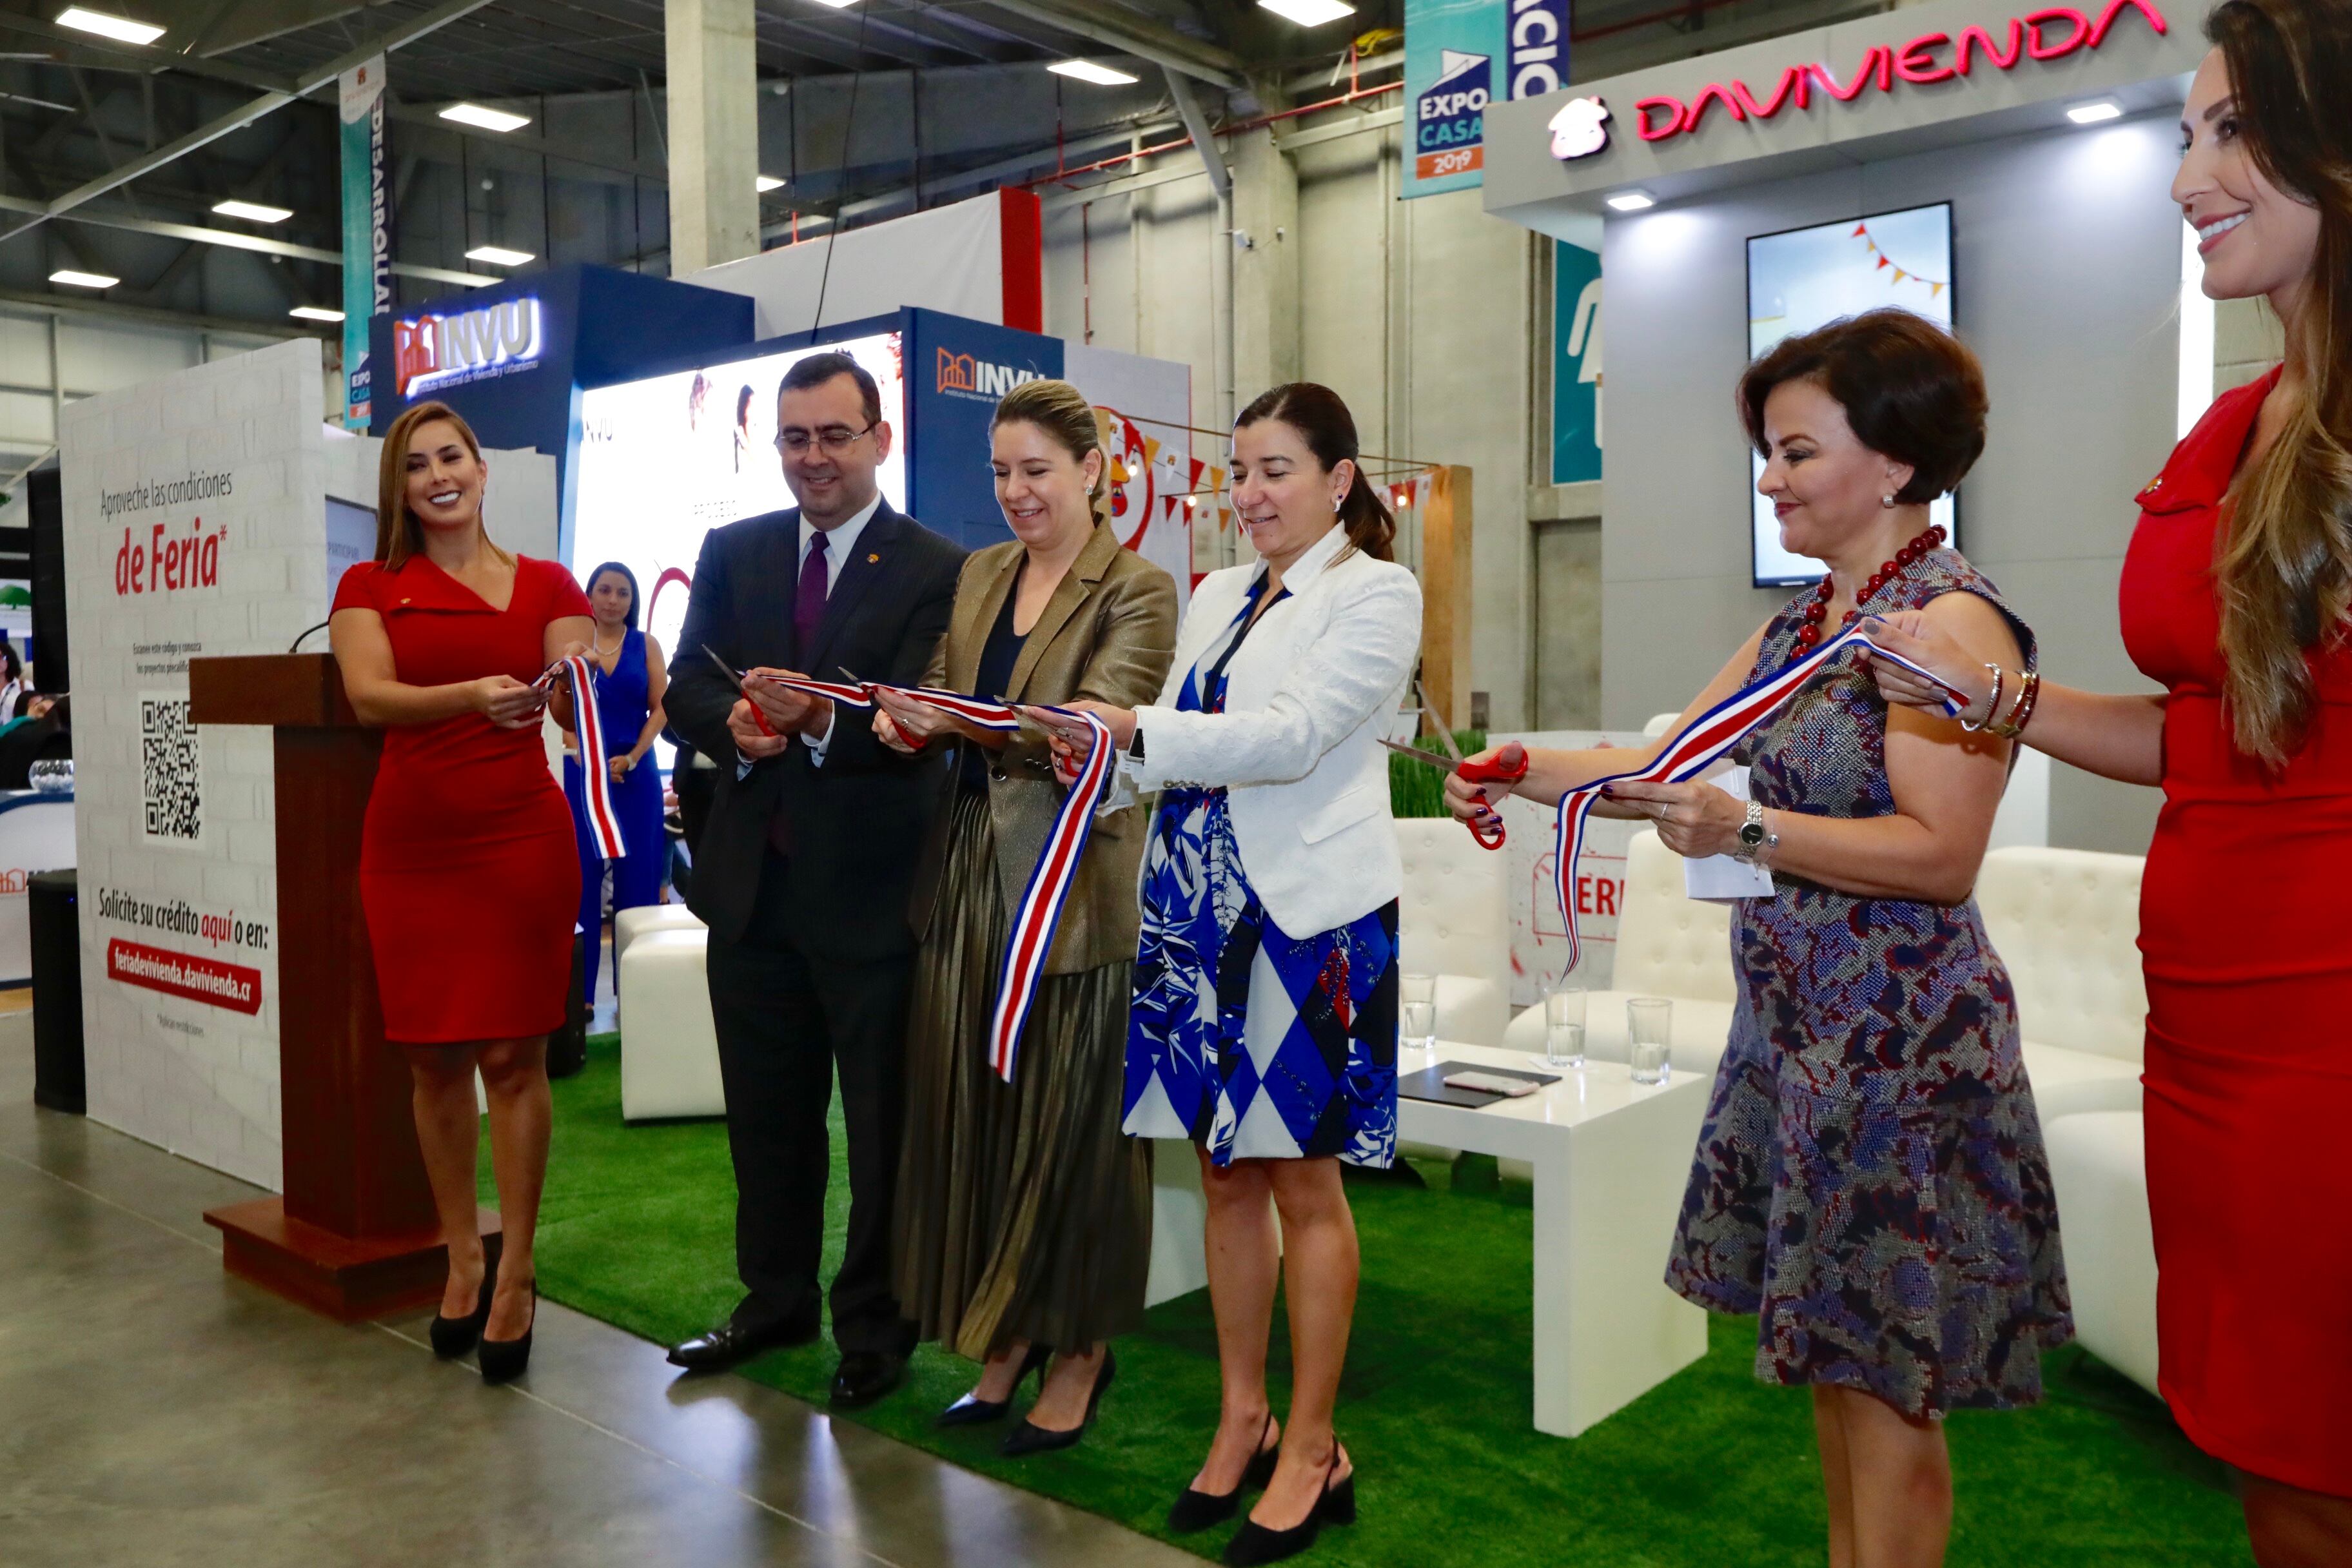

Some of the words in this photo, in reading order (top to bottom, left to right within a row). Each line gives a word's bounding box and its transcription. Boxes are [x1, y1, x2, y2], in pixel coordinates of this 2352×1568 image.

[1513, 0, 1558, 100] CIO
[1634, 0, 2168, 141] DAVIVIENDA
[1419, 117, 1483, 148] CASA
[1420, 88, 1489, 121] EXPO
[1433, 151, 1472, 175] 2019
[438, 298, 532, 370] INVU
[976, 361, 1046, 397] INV
[100, 481, 149, 524] Aproveche
[152, 479, 166, 507] las
[168, 471, 233, 505] condiciones
[115, 527, 144, 596] de
[99, 887, 139, 923] Solicite
[141, 903, 153, 927] su
[155, 899, 199, 936] crédito
[201, 909, 233, 948] aquí
[235, 921, 243, 945] o
[246, 923, 268, 950] en:
[115, 946, 251, 1002] feriadevivienda.davivienda.cr
